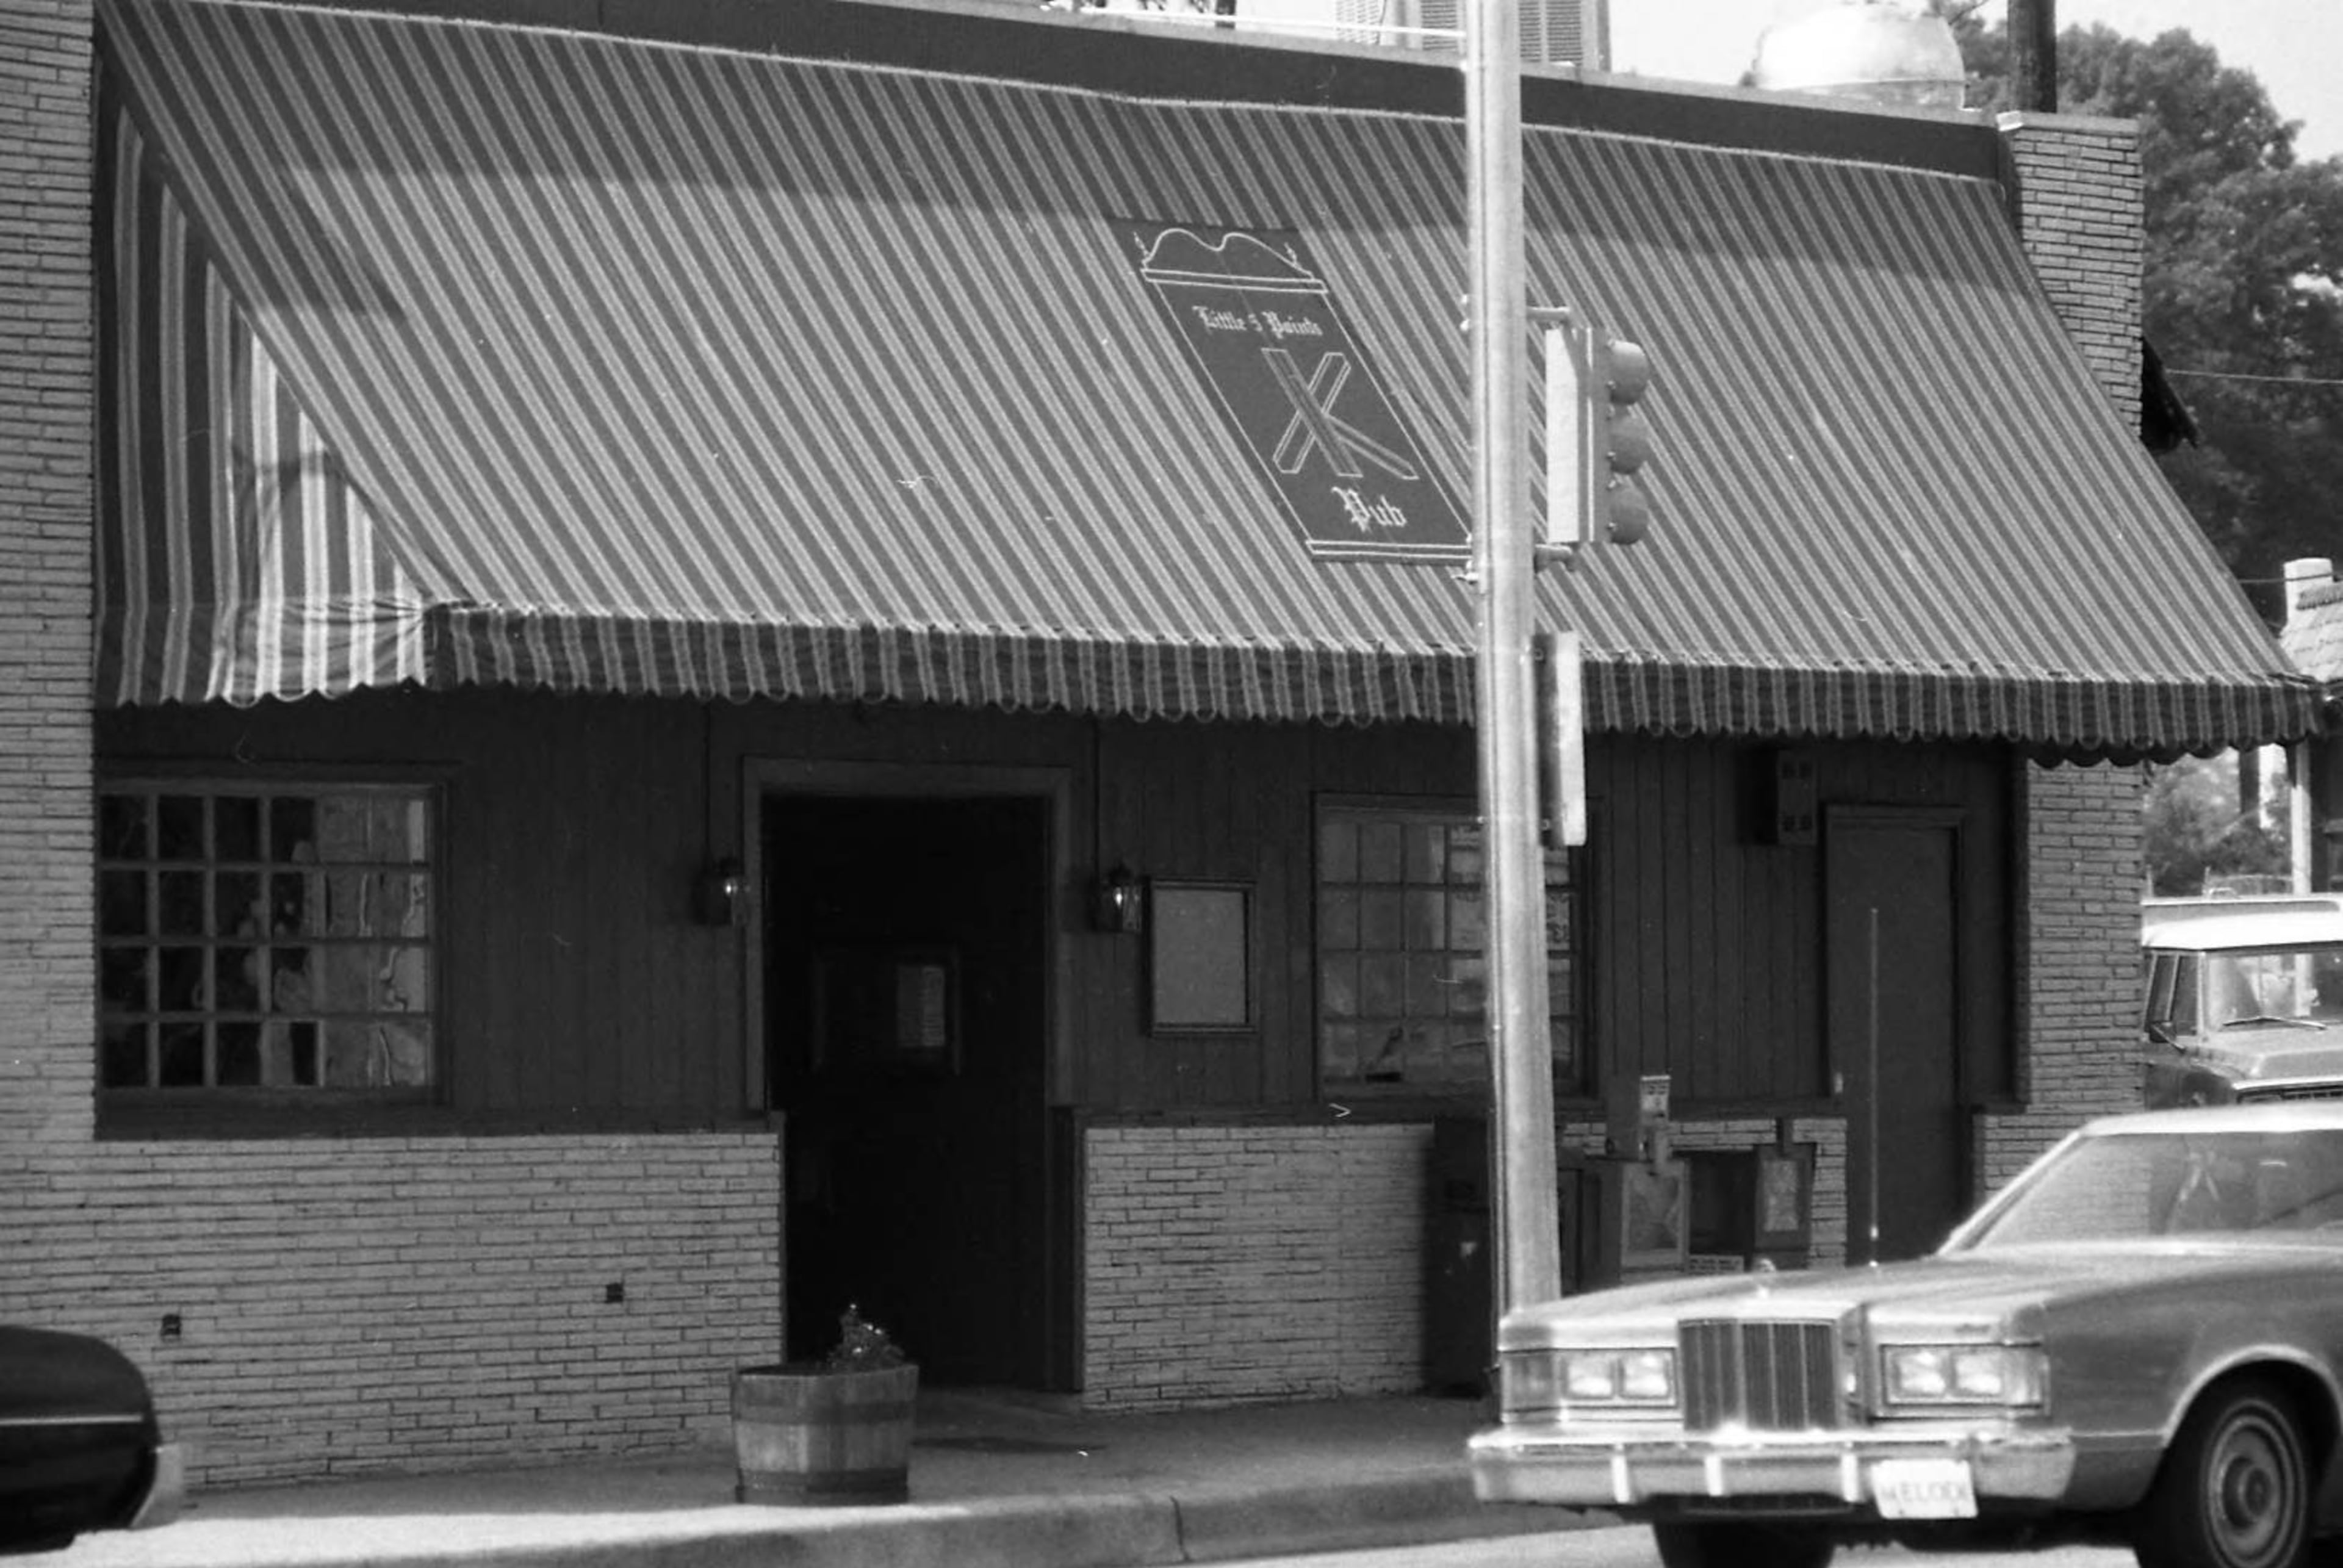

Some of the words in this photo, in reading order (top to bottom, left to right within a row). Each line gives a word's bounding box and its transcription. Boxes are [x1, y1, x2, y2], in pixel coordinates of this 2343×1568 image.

[1192, 305, 1247, 333] Little
[1261, 311, 1323, 339] Points
[1331, 487, 1407, 533] Pub
